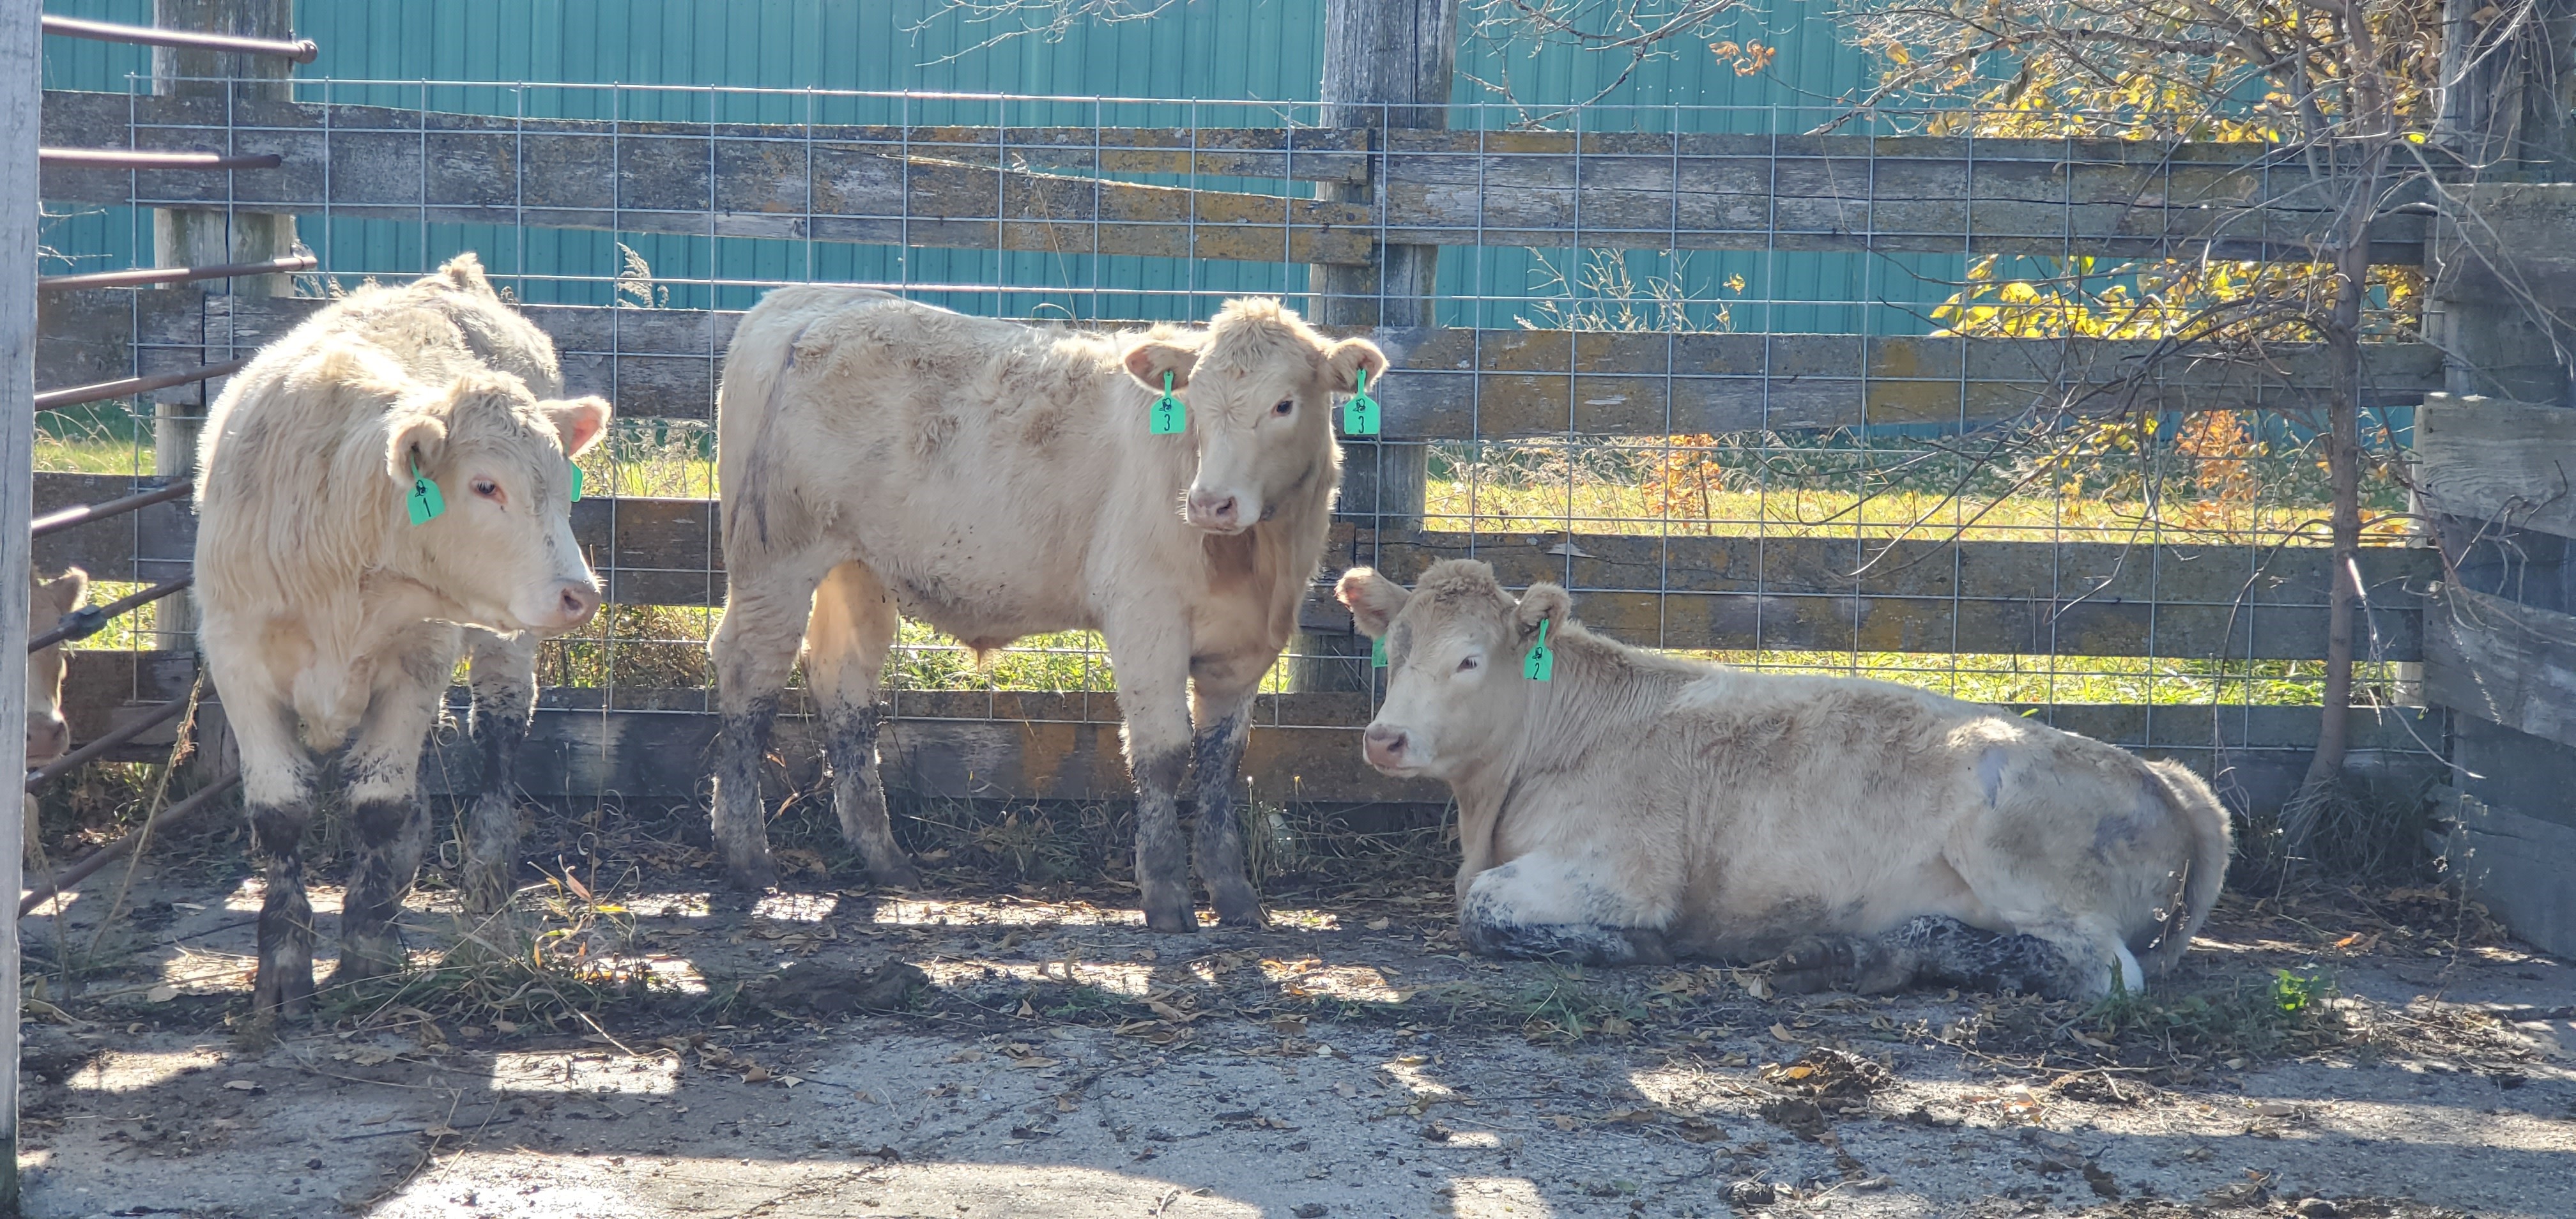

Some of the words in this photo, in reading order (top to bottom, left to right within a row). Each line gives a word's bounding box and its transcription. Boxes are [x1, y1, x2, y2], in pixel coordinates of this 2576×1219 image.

[1163, 413, 1170, 431] 3
[1358, 415, 1365, 434] 3
[423, 497, 431, 517] 1
[1533, 662, 1540, 680] 2
